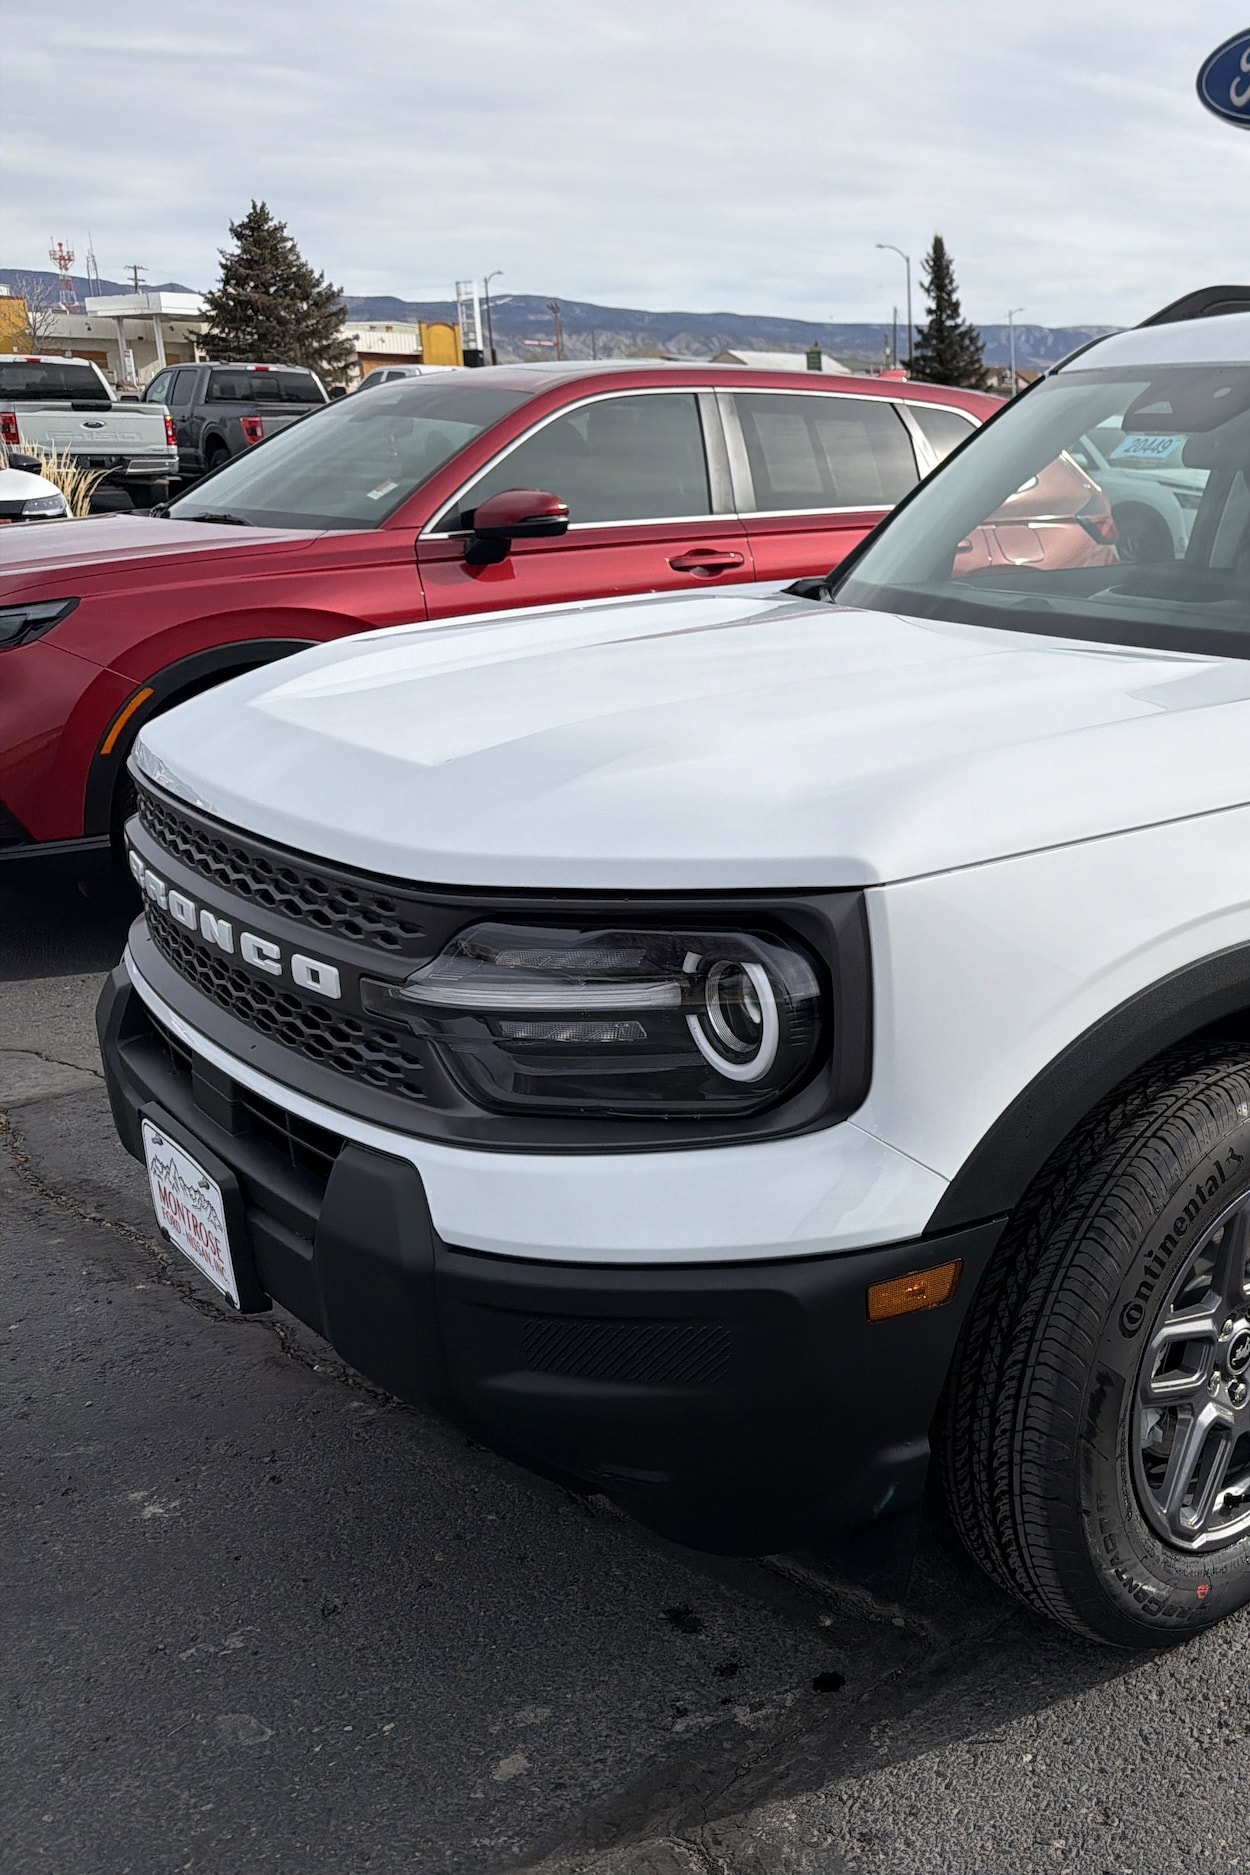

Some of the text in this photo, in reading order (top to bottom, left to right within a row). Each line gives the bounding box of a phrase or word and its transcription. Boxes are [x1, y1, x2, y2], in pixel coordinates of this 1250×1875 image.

[1123, 438, 1172, 454] 20449
[129, 850, 341, 999] BRONCO
[157, 1180, 224, 1263] MONTROSE
[1118, 1159, 1227, 1339] Continental
